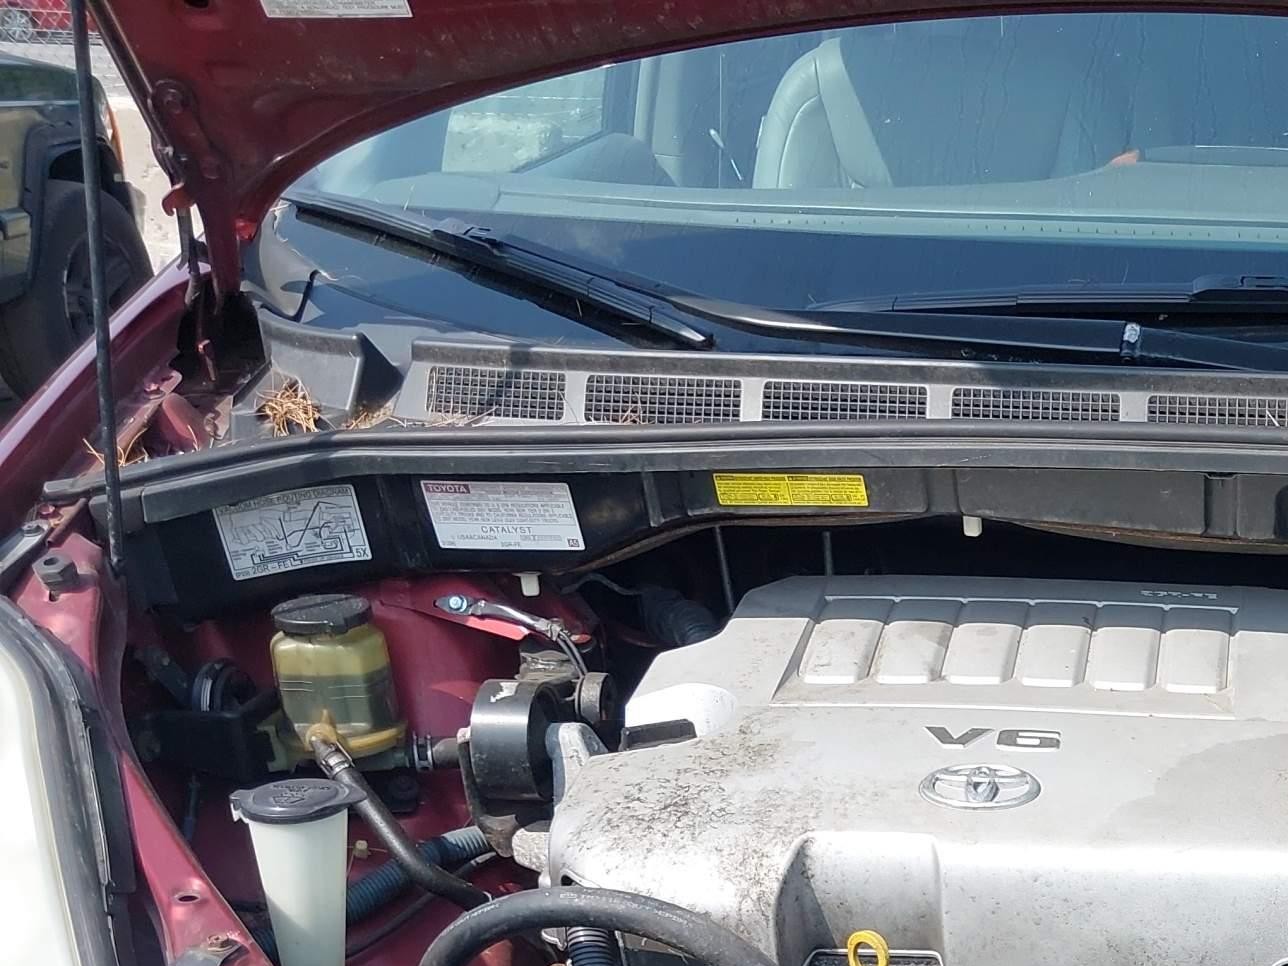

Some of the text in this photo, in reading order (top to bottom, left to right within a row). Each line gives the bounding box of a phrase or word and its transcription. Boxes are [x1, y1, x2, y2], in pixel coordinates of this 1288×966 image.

[426, 483, 467, 494] TOYOTA
[480, 525, 533, 534] CATALYST
[355, 547, 369, 559] 5X
[925, 725, 1062, 750] V6
